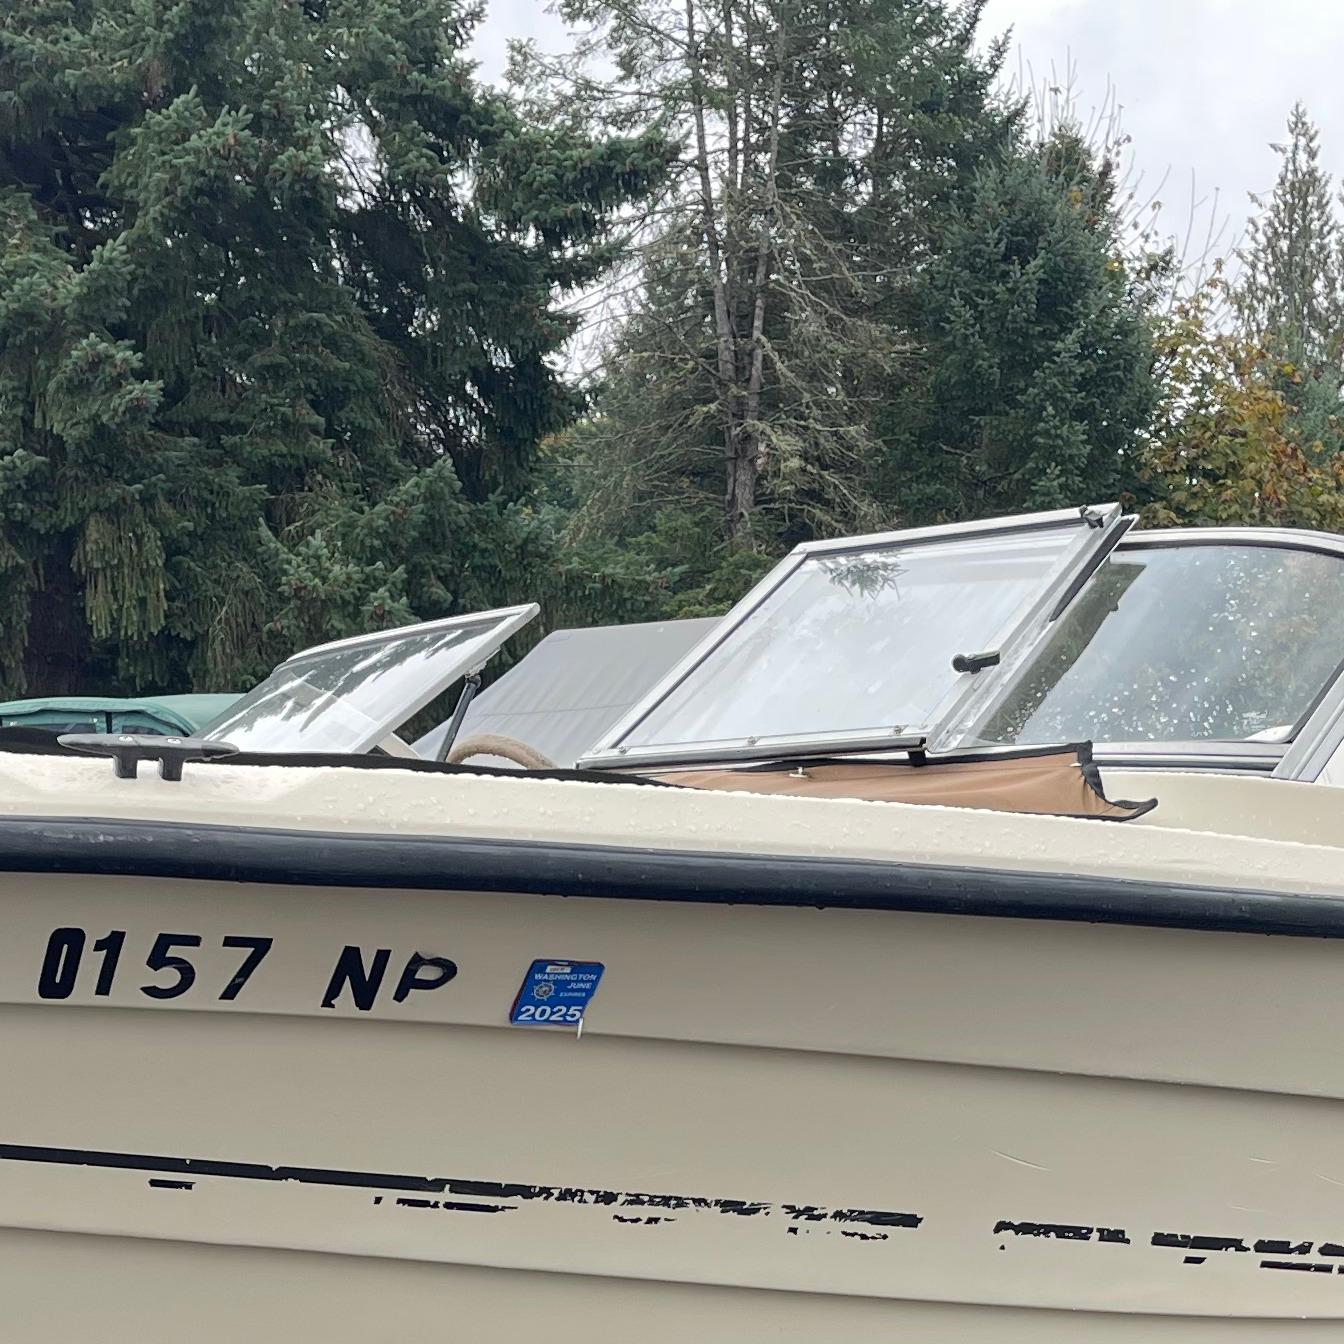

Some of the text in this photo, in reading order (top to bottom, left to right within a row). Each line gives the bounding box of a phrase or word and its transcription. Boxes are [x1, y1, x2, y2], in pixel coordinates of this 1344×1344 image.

[38, 927, 274, 1000] 0157
[320, 945, 458, 1011] NP
[535, 973, 597, 981] WASHINGTON
[517, 1005, 583, 1021] 2025
